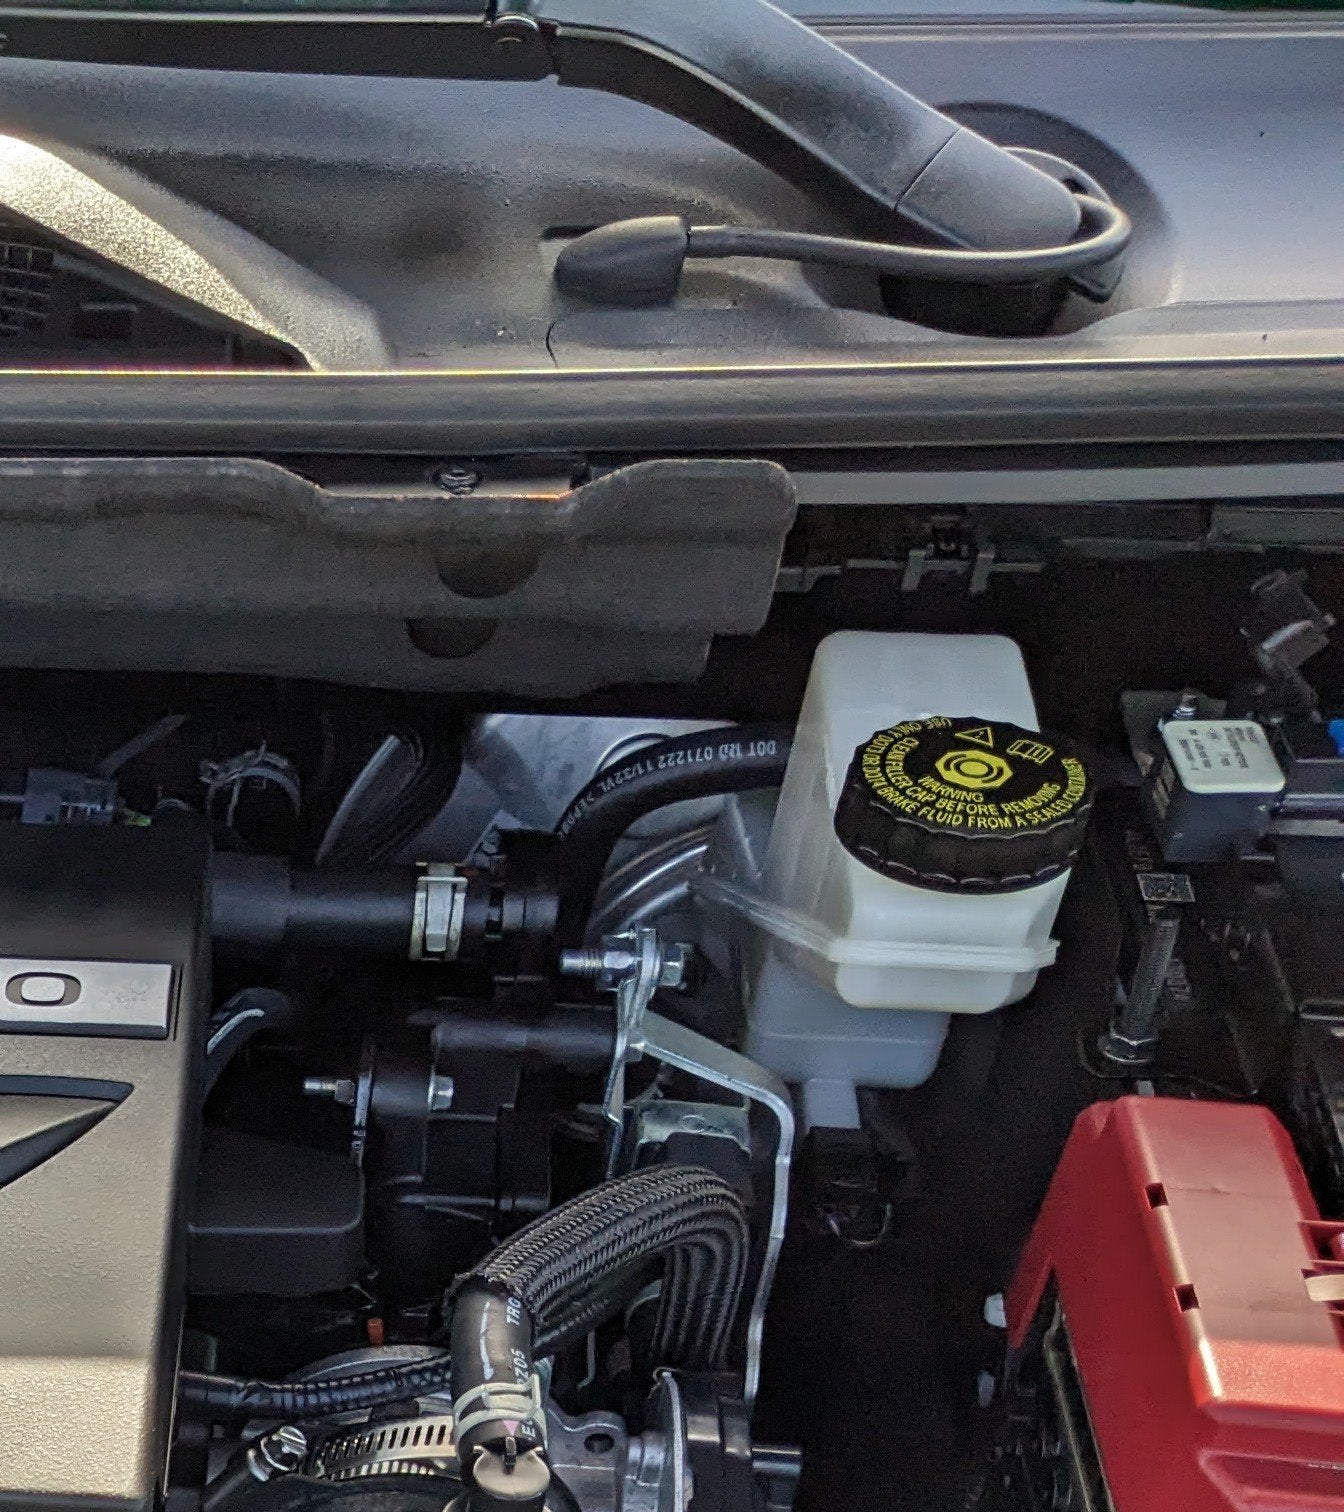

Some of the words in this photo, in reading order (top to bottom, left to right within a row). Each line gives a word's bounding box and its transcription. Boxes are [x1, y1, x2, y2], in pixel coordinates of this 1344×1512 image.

[877, 783, 920, 813] BRAKE
[918, 807, 962, 827] FLUID
[968, 816, 1012, 829] FROM
[1015, 815, 1027, 827] A
[1025, 799, 1070, 825] SEALED
[906, 783, 937, 803] CAP
[936, 798, 997, 816] BEFORE
[1002, 782, 1062, 815] REMOVING
[918, 775, 985, 803] WARNING
